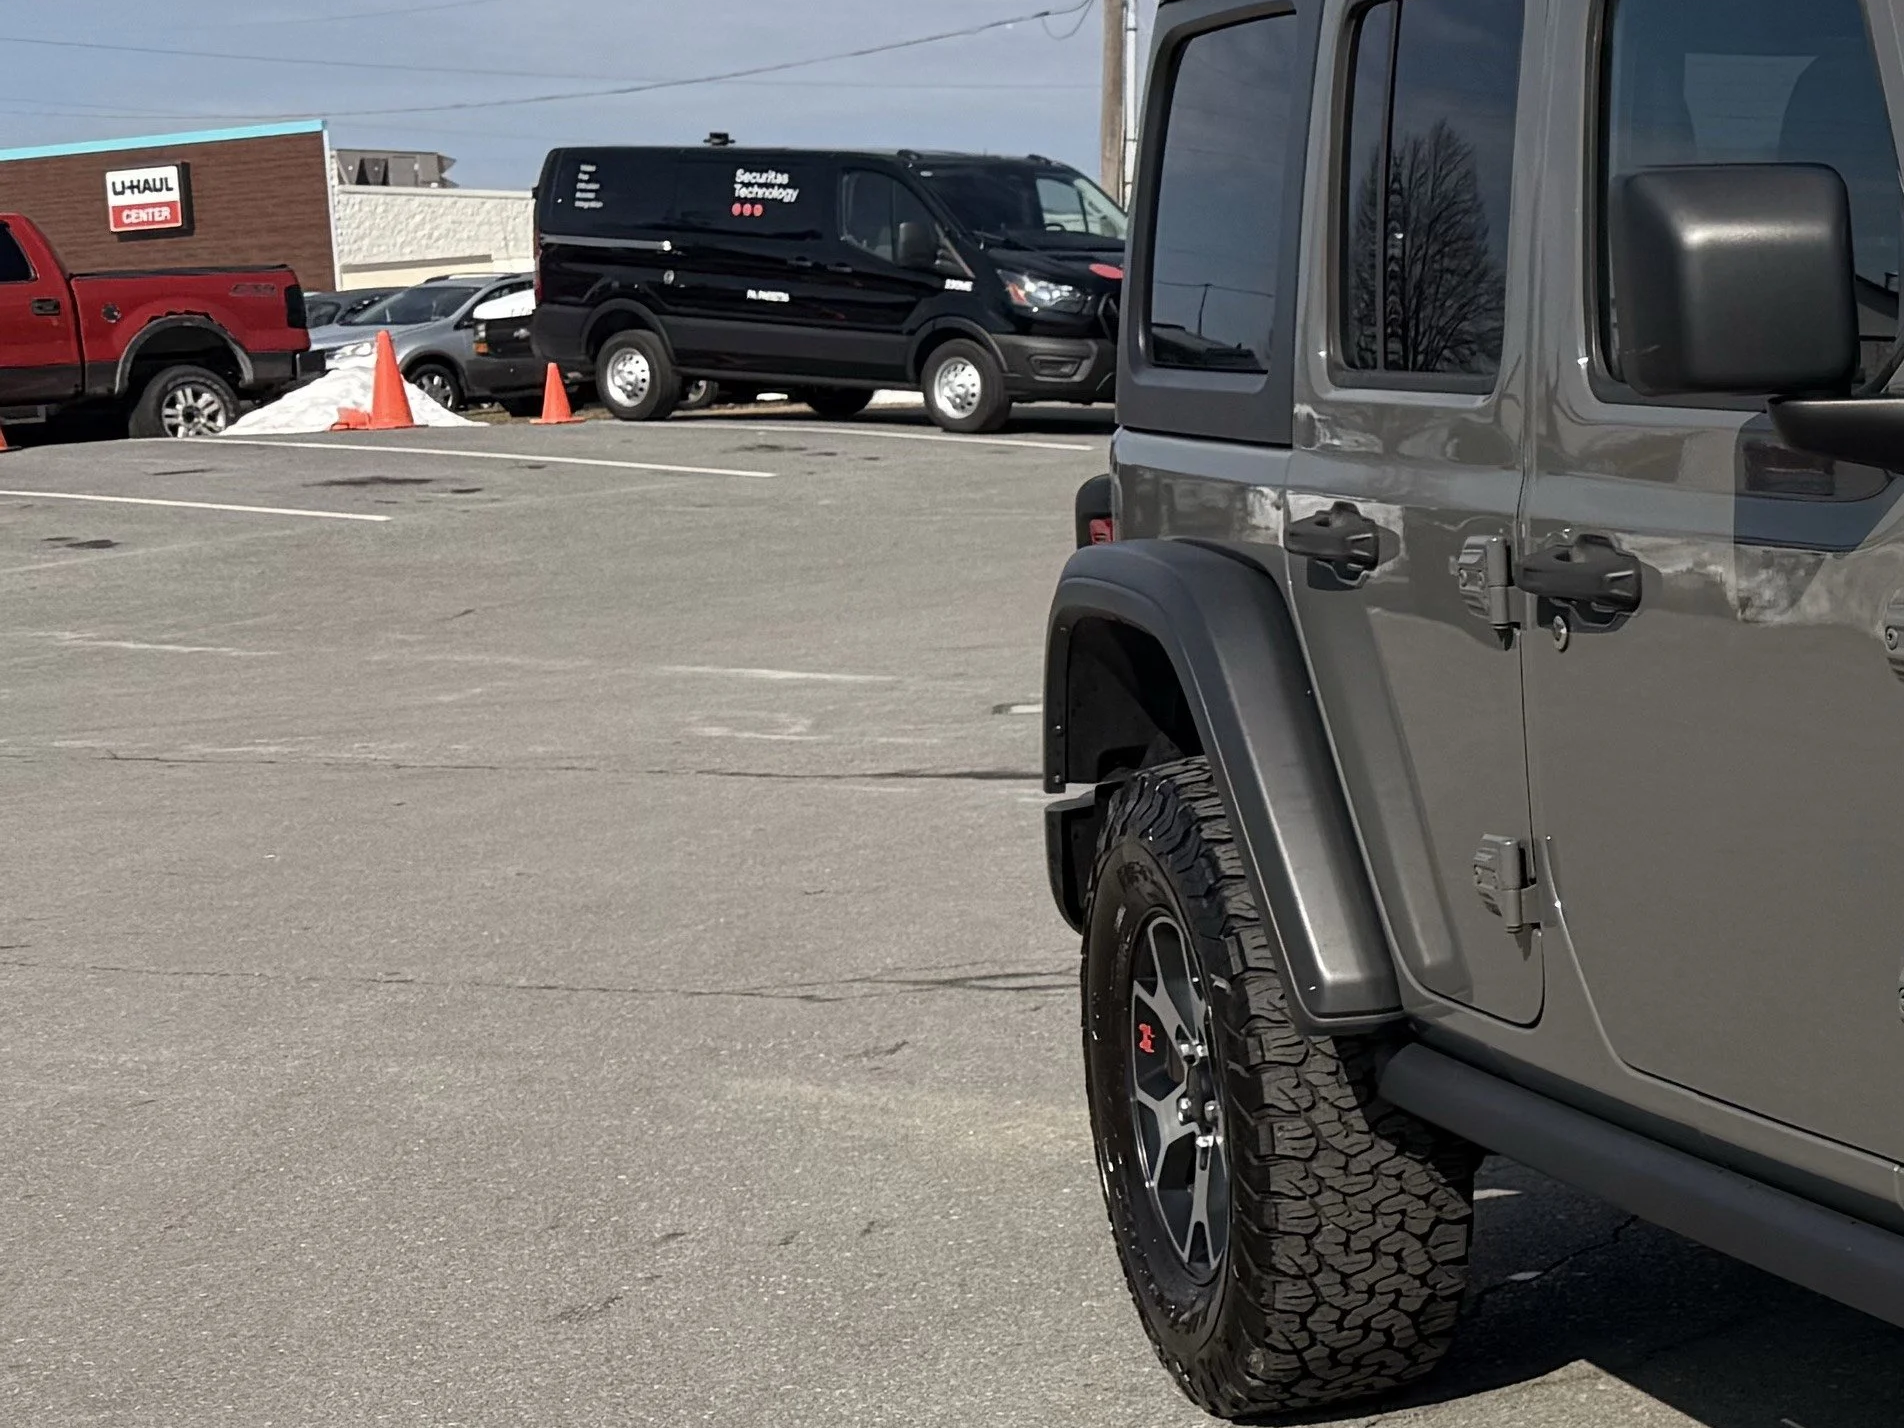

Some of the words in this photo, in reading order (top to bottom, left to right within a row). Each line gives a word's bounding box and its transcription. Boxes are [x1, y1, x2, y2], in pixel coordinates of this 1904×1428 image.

[735, 168, 789, 184] Securitas
[112, 177, 174, 196] U-HAUL
[734, 183, 799, 203] Technology
[122, 206, 171, 224] CENTER
